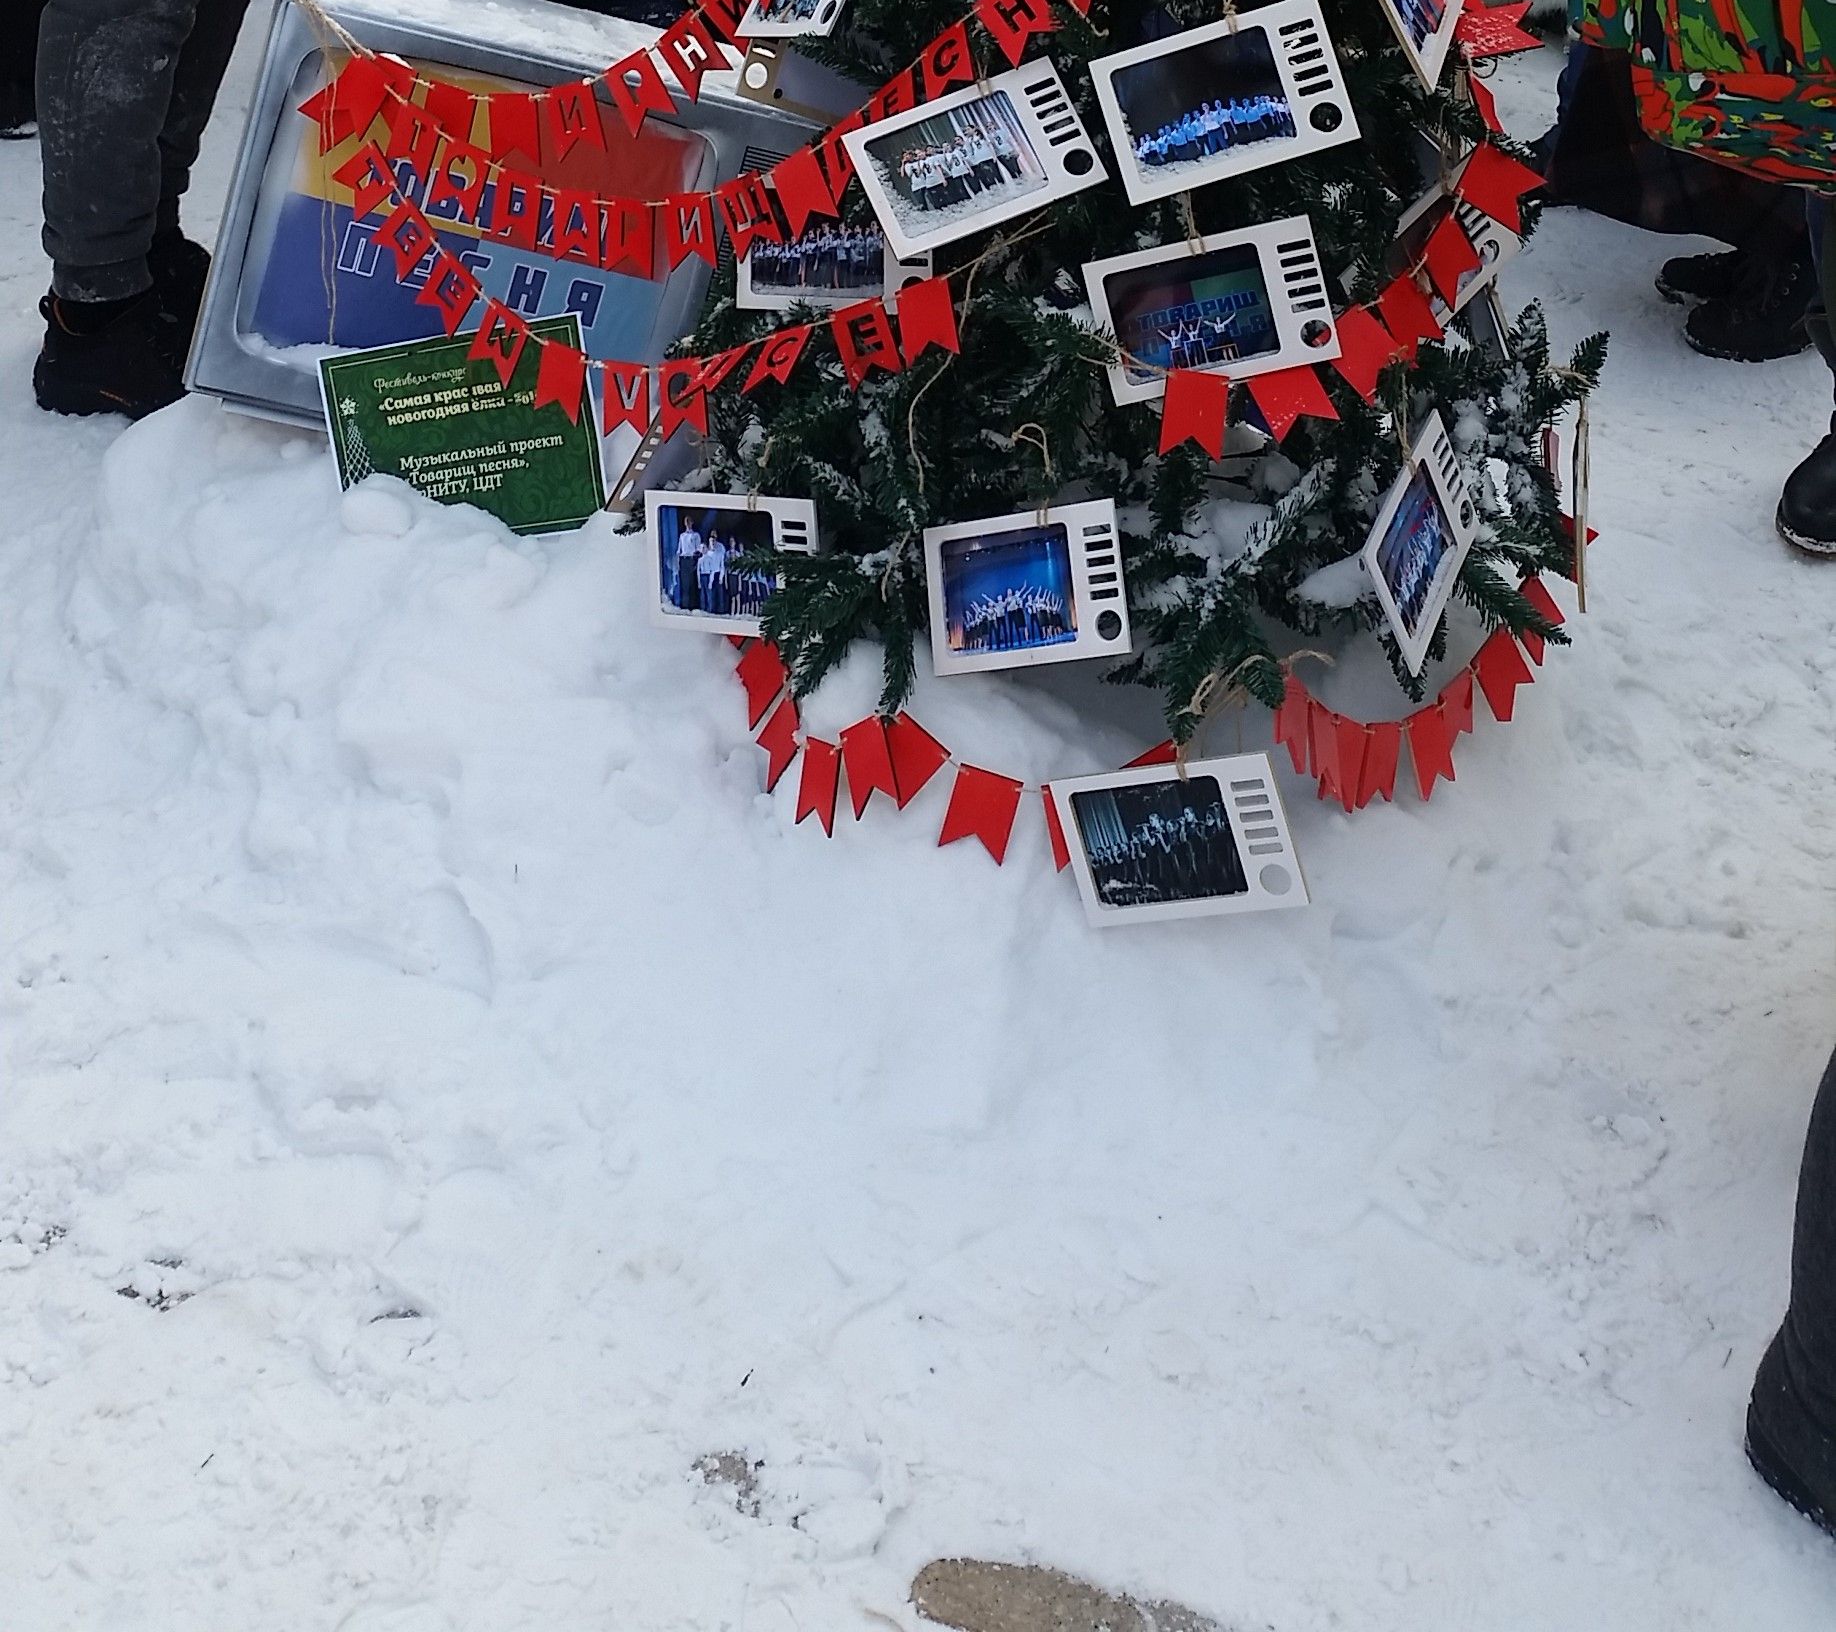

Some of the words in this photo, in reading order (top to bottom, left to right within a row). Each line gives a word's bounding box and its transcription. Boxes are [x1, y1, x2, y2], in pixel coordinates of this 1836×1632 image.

[1138, 290, 1261, 330] ТОВАРИЩ
[379, 391, 432, 411] «Самая
[387, 402, 470, 426] новогодняя
[471, 397, 506, 411] ёлка
[514, 390, 537, 406] 201
[400, 440, 507, 472] Музыкальный
[509, 435, 564, 455] проект
[478, 458, 530, 474] песня»,
[473, 473, 504, 492] ЦДТ
